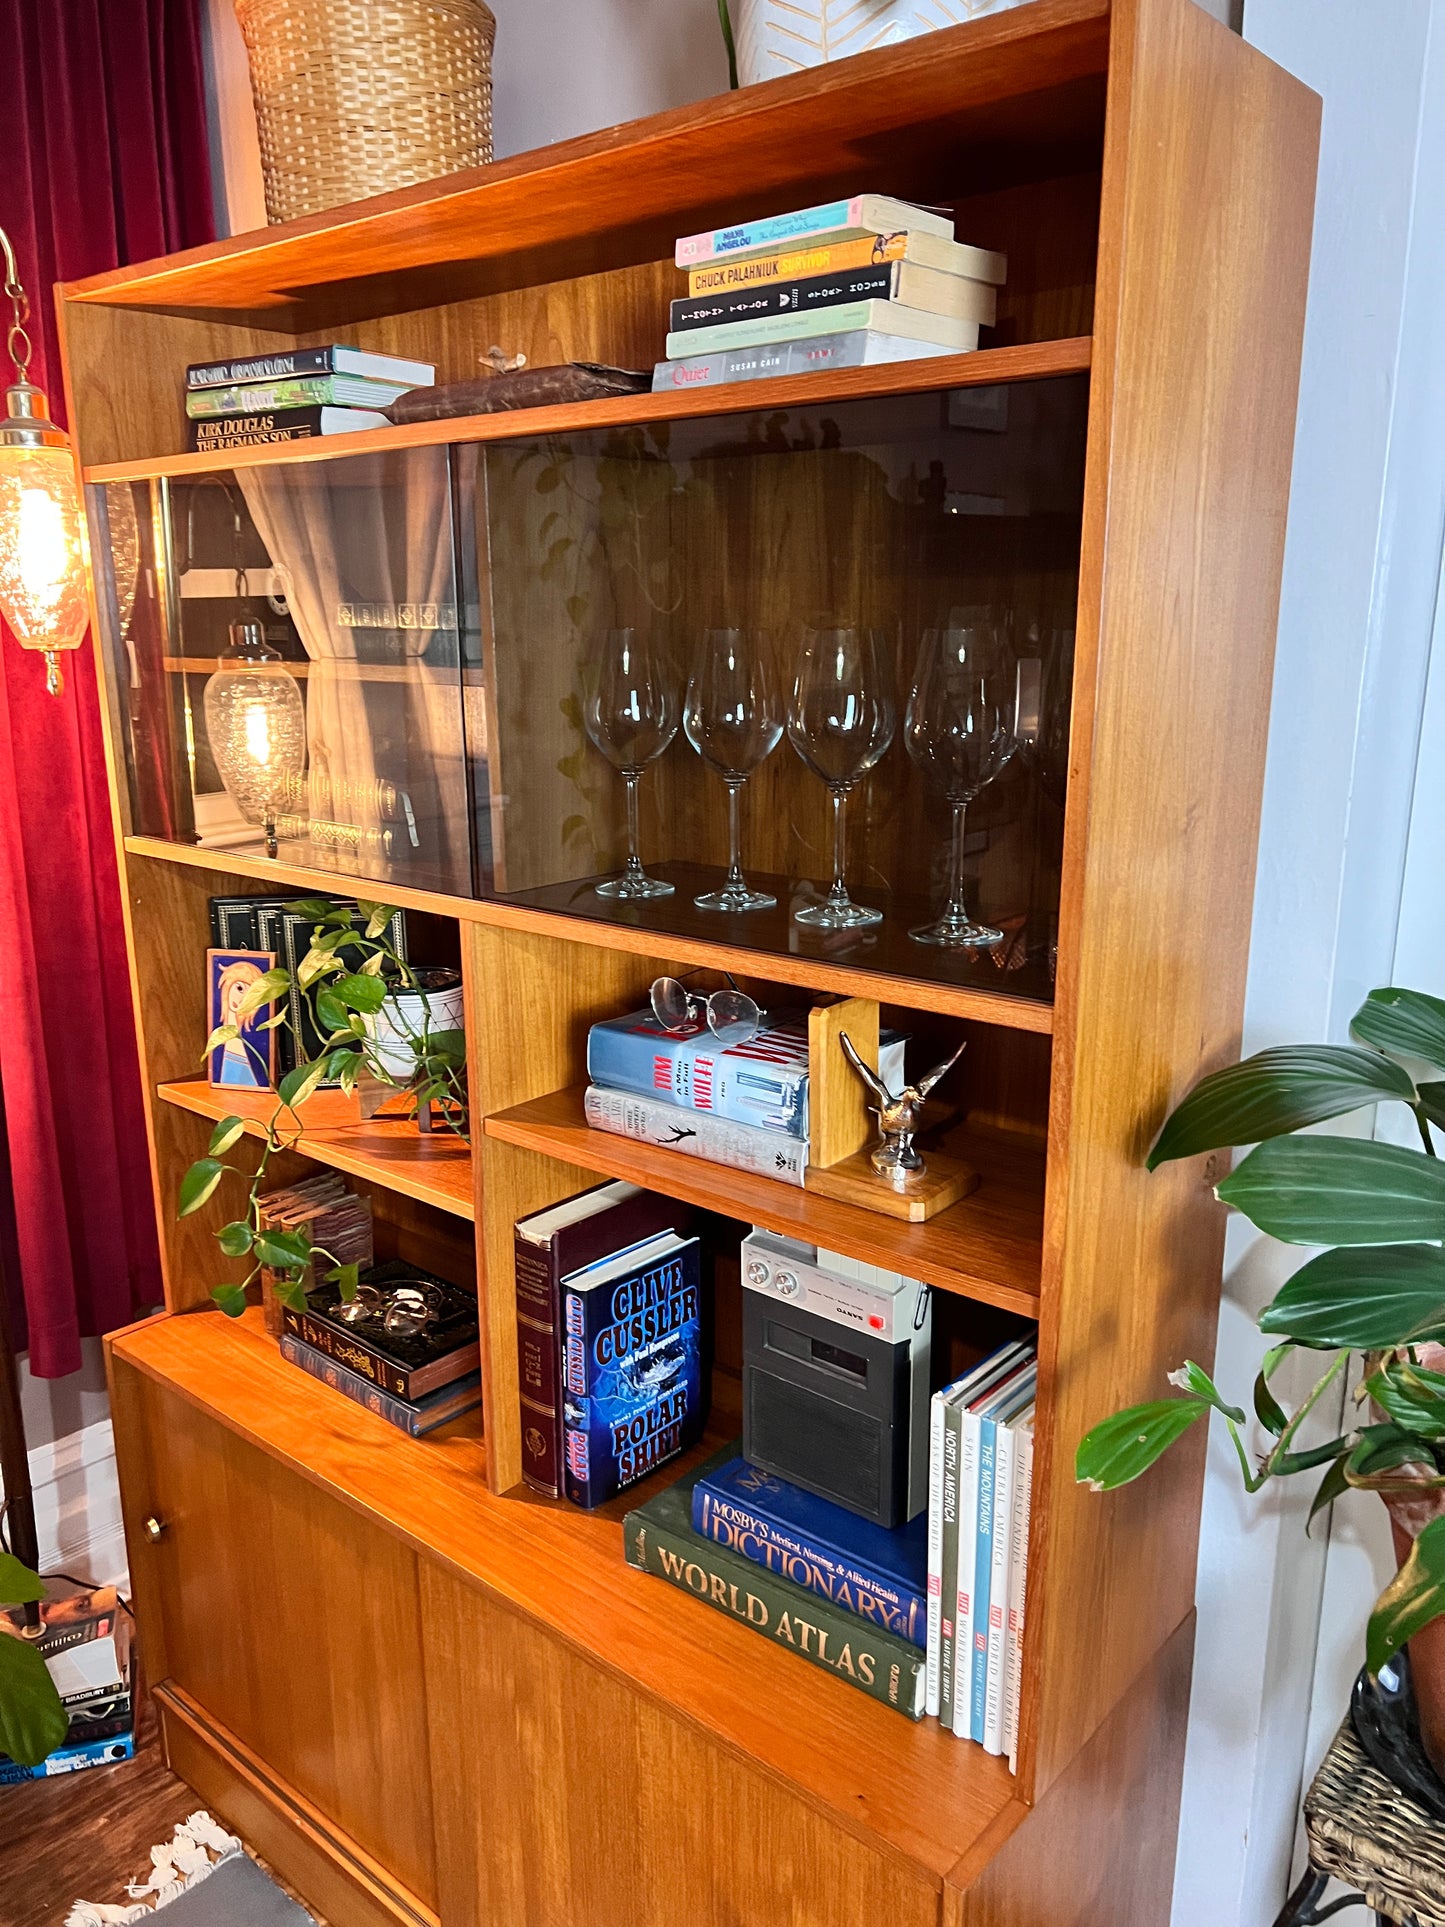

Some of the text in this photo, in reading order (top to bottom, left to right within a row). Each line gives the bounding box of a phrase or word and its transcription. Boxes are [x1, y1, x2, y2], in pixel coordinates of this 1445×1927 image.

[695, 251, 831, 290] CHUCK PALAHNIUK SURVIVOR
[716, 236, 752, 253] ANGELOU
[681, 280, 888, 321] TIMOTHY TAYLOR STORY HOUSE
[671, 356, 781, 386] Quiet SUSAN CAIN
[197, 415, 274, 439] KIRK DOUGLAS
[197, 440, 216, 452] THE
[270, 430, 291, 443] SON
[653, 1055, 672, 1091] TOM
[693, 1055, 714, 1109] WOLFE
[590, 1095, 601, 1125] MARY
[612, 1258, 683, 1323] CLIVE
[836, 1306, 864, 1321] SANYO
[567, 1293, 585, 1396] CLIVE CUSSLER
[594, 1285, 697, 1367] CUSSLER
[612, 1387, 688, 1457] POLAR
[619, 1422, 682, 1482] SHIFT
[574, 1430, 589, 1481] POLAR
[944, 1428, 957, 1523] NORTH AMERICA
[964, 1437, 974, 1471] SPAIN
[930, 1424, 940, 1551] ATLAS OF THE WORLD
[980, 1444, 993, 1535] THE MOUNTAINS
[994, 1449, 1008, 1567] CENTRAL AMERICA
[1014, 1453, 1026, 1565] THE WEST INDIES
[712, 1514, 902, 1632] DICTIONARY
[713, 1498, 899, 1604] MOSBY'S Medical, Nursing, & Allied Health
[657, 1546, 876, 1686] WORLD ATLAS
[928, 1574, 940, 1699] LIFE WORLD LIBRARY
[1009, 1608, 1018, 1633] LIFE
[943, 1617, 952, 1704] LIFE NATURE LIBRARY
[956, 1590, 969, 1717] LIFE WORLD LIBRARY
[975, 1632, 986, 1718] LIFE NATURE LIBRARY
[987, 1604, 1002, 1731] LIFE WORLD LIBRARY
[1006, 1636, 1016, 1681] WORLD
[65, 1688, 105, 1704] BRADBURY
[1004, 1686, 1014, 1736] LIBRARY
